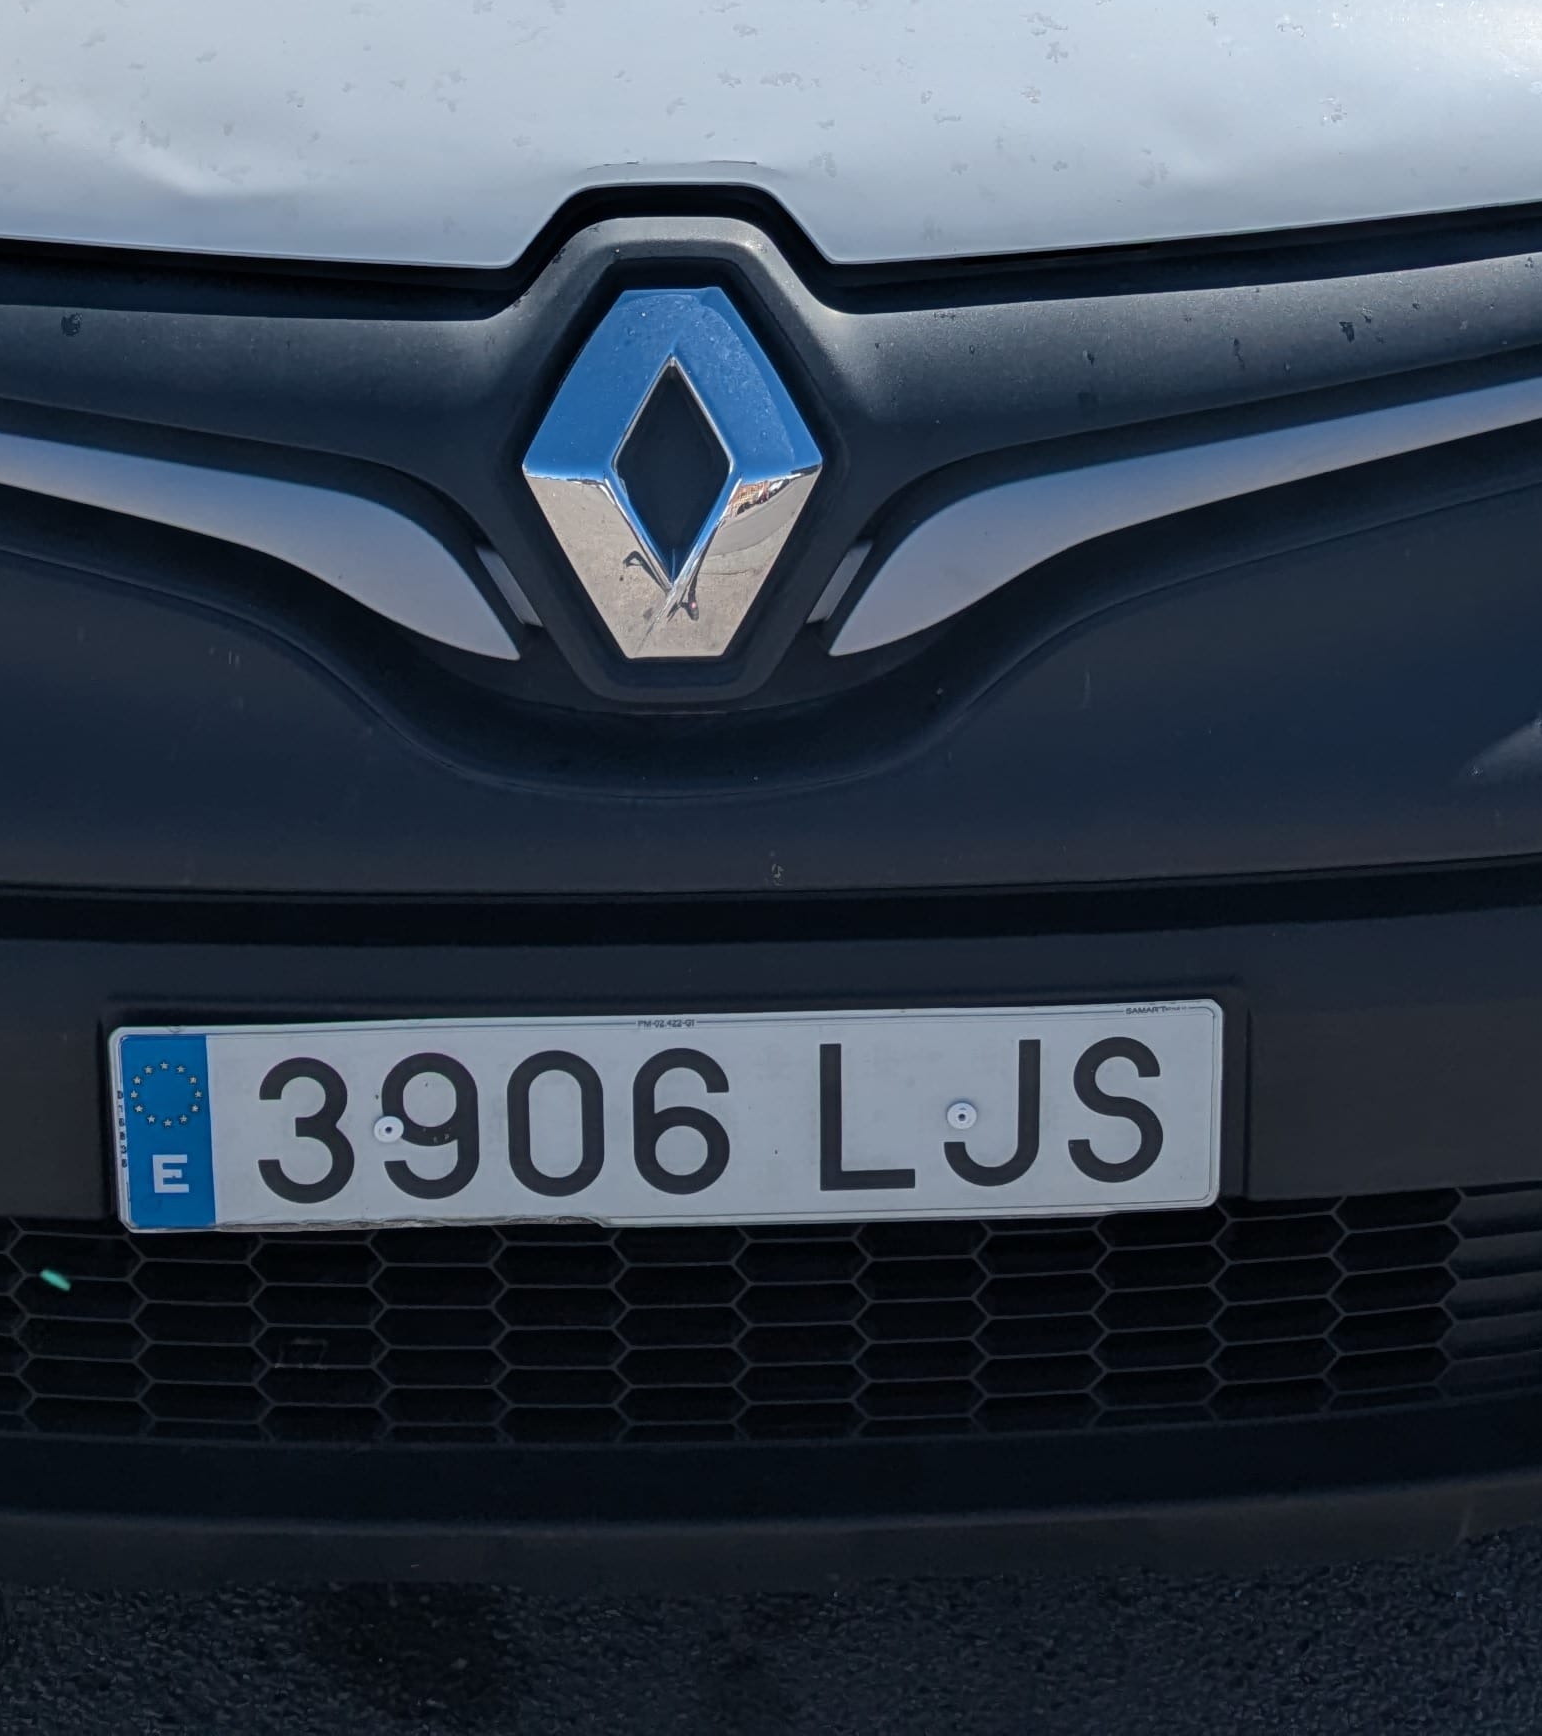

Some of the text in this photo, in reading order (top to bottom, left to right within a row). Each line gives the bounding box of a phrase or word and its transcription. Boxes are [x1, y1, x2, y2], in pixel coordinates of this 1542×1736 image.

[259, 1037, 1164, 1204] 3906 LJS
[152, 1154, 190, 1194] E
